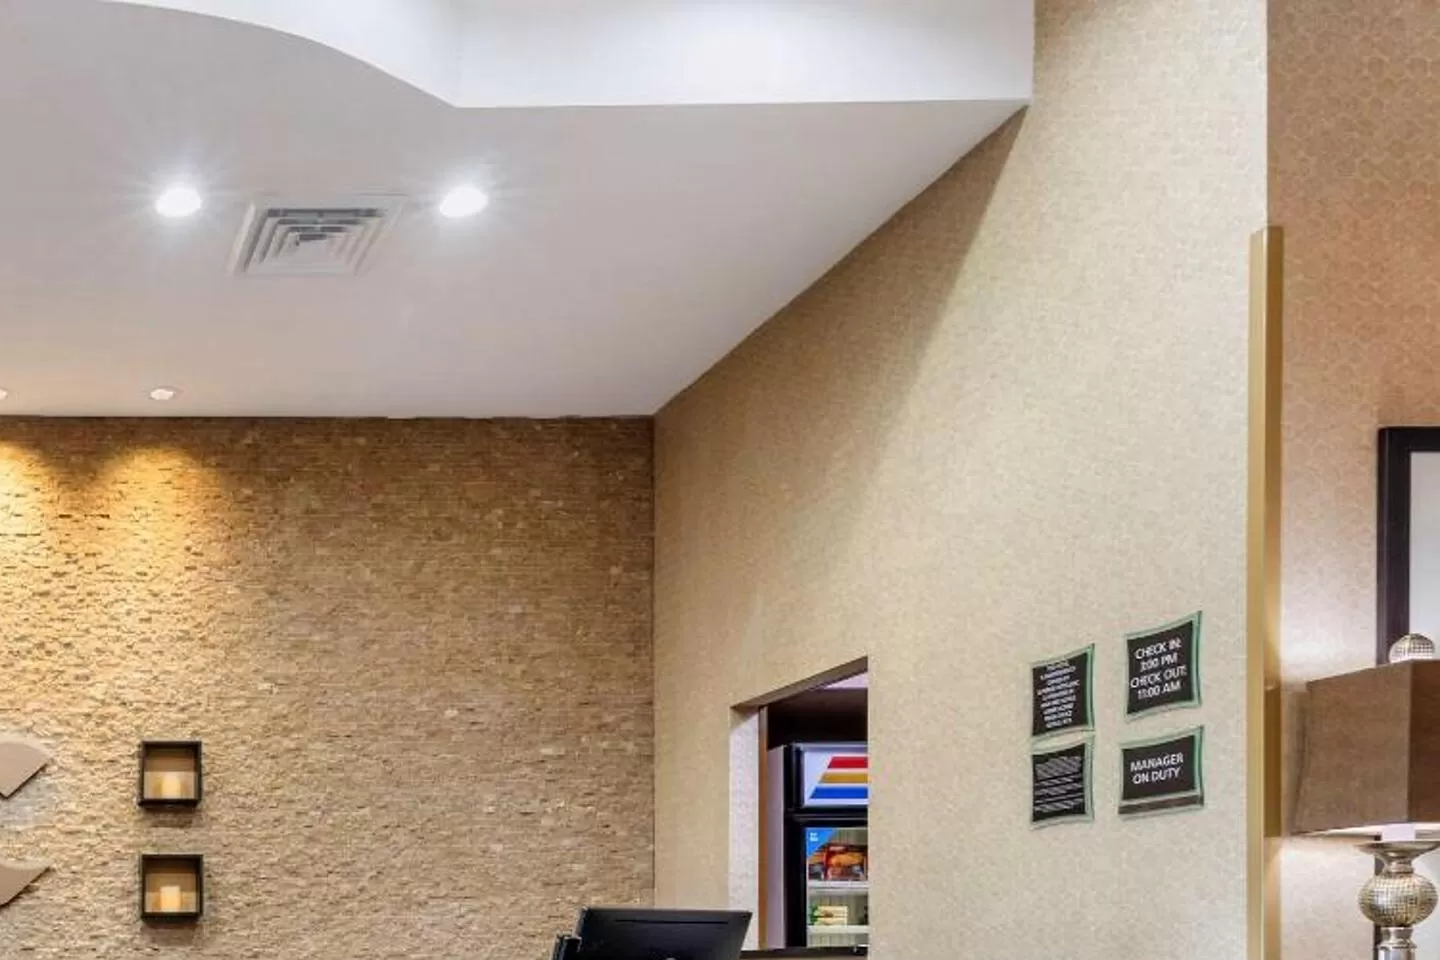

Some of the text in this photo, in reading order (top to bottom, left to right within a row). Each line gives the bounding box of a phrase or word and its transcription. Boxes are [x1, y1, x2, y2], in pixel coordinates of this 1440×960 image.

[1135, 641, 1166, 659] CHECK
[1161, 652, 1178, 665] PM
[1130, 671, 1162, 688] CHECK
[1162, 680, 1181, 694] AM
[1130, 752, 1184, 772] MANAGER
[1132, 767, 1180, 784] ON DUTY
